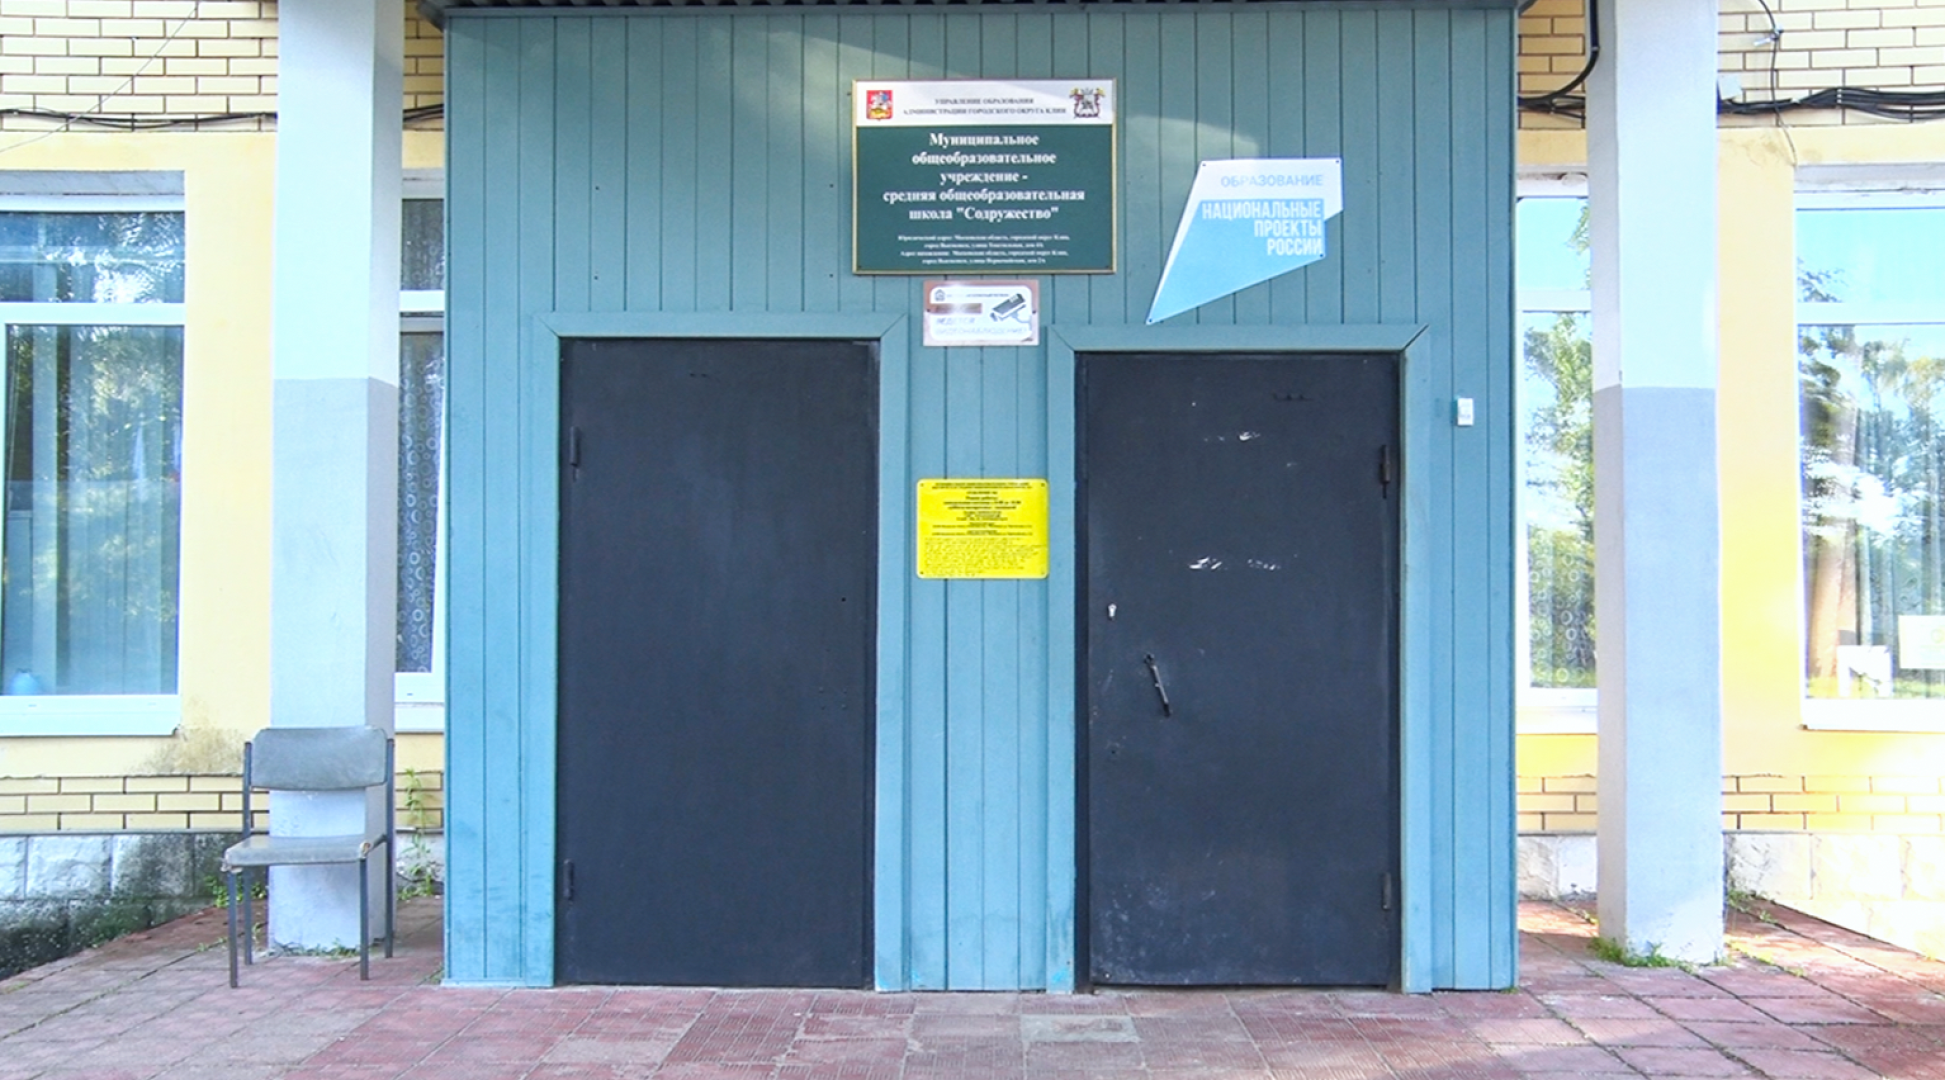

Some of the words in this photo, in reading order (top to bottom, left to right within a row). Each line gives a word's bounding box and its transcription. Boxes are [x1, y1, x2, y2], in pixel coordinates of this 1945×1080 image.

[929, 133, 1040, 149] Муниципальное
[912, 151, 1057, 167] общеобразовательное
[939, 172, 1020, 186] учреждение
[1220, 174, 1324, 188] ОБРАЗОВАНИЕ
[883, 190, 937, 205] средняя
[938, 188, 1085, 205] общеобразовательная
[908, 209, 953, 220] школа
[956, 206, 1060, 223] "Содружество"
[1201, 201, 1322, 221] НАЦИОНАЛЬНЫЕ
[1253, 219, 1322, 237] ПРОЕКТЫ
[1266, 238, 1323, 256] РОССИИ
